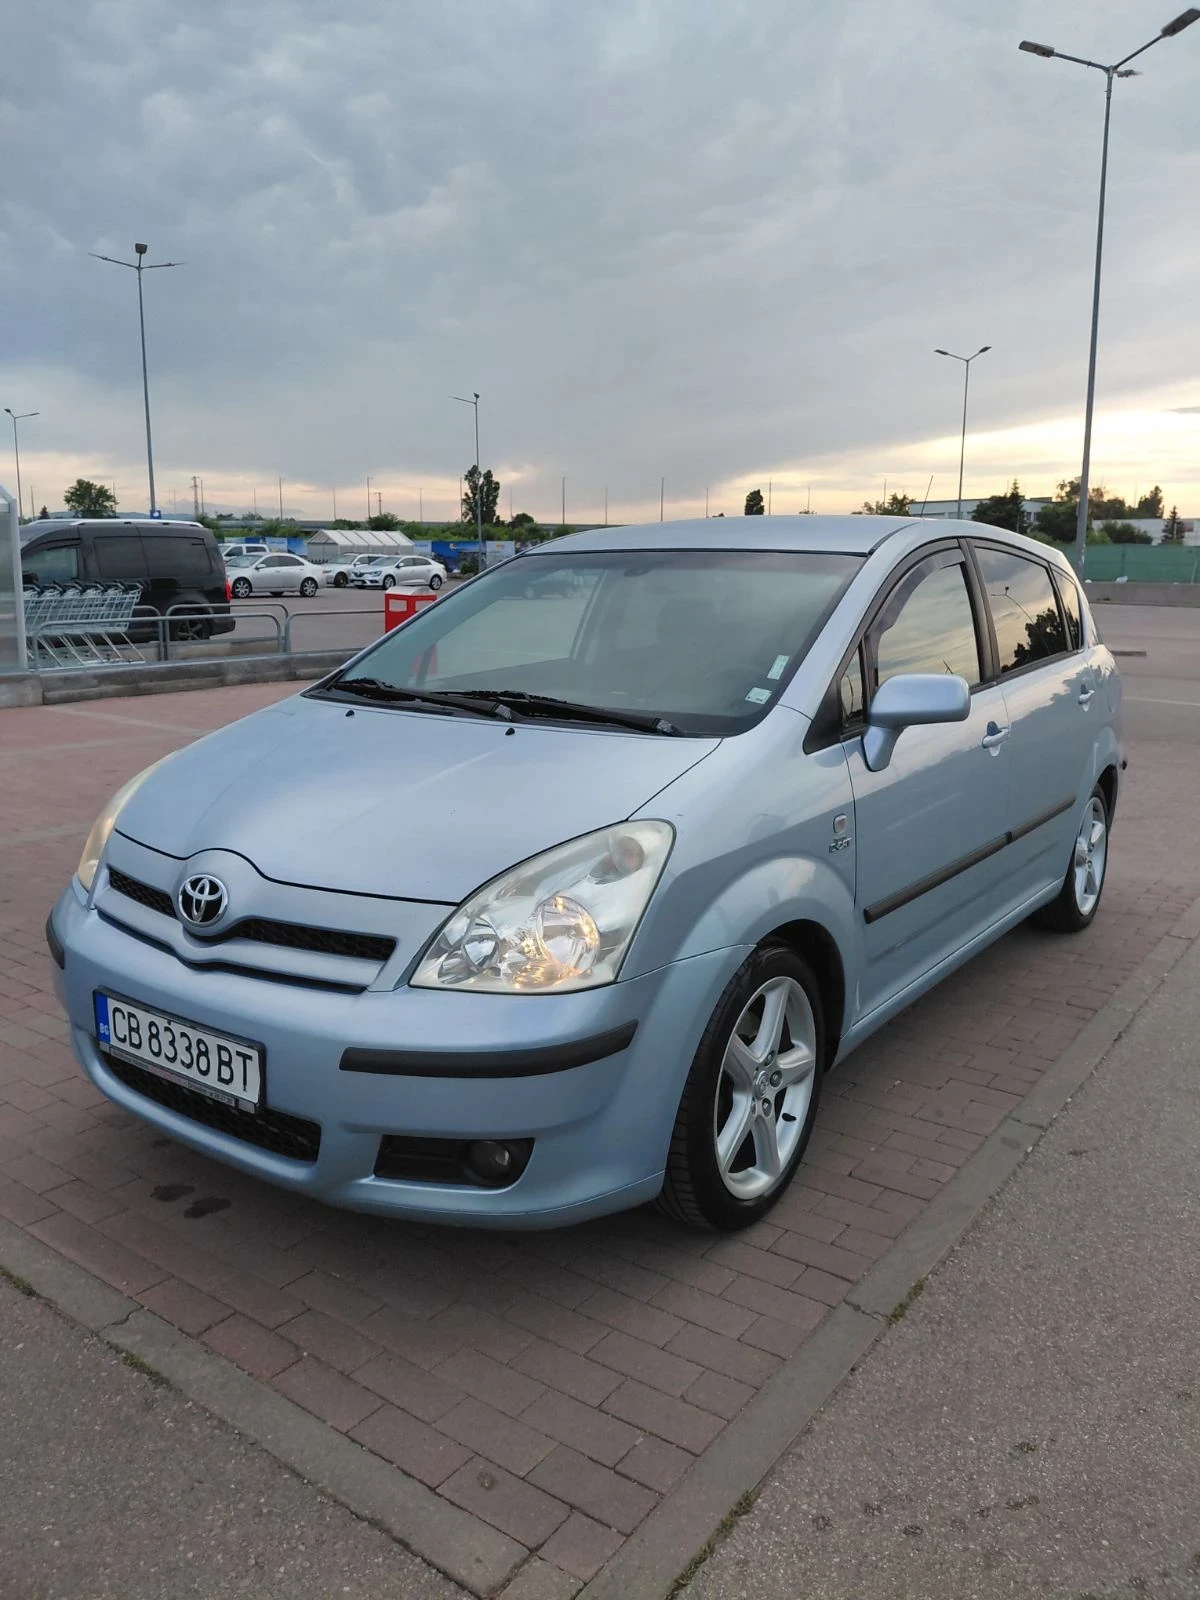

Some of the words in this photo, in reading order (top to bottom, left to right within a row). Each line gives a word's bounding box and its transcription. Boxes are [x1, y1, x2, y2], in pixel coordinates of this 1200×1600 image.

[99, 1022, 110, 1036] BG
[112, 1006, 142, 1050] CB
[148, 1020, 211, 1077] 8338
[216, 1043, 253, 1092] BT
